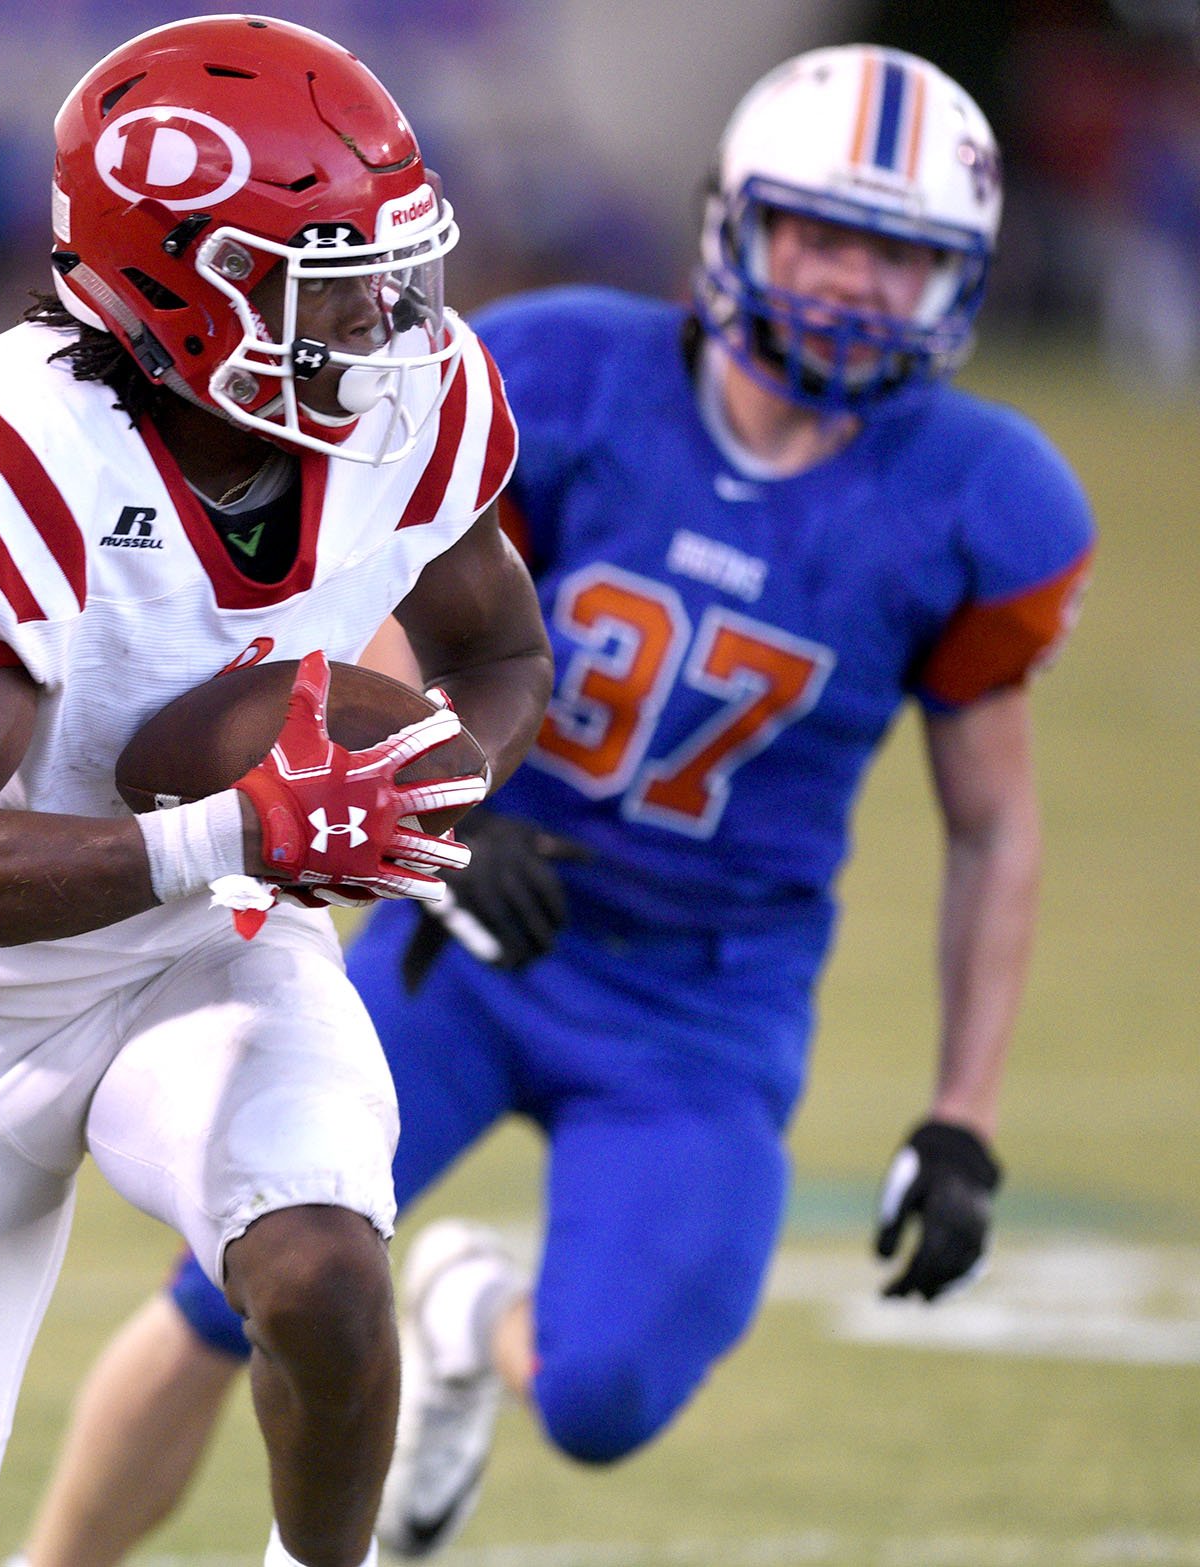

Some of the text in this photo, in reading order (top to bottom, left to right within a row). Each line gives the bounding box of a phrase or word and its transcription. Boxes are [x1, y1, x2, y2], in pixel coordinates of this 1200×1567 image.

[108, 115, 235, 201] D
[98, 536, 164, 549] RUSSELL
[526, 560, 837, 841] 37
